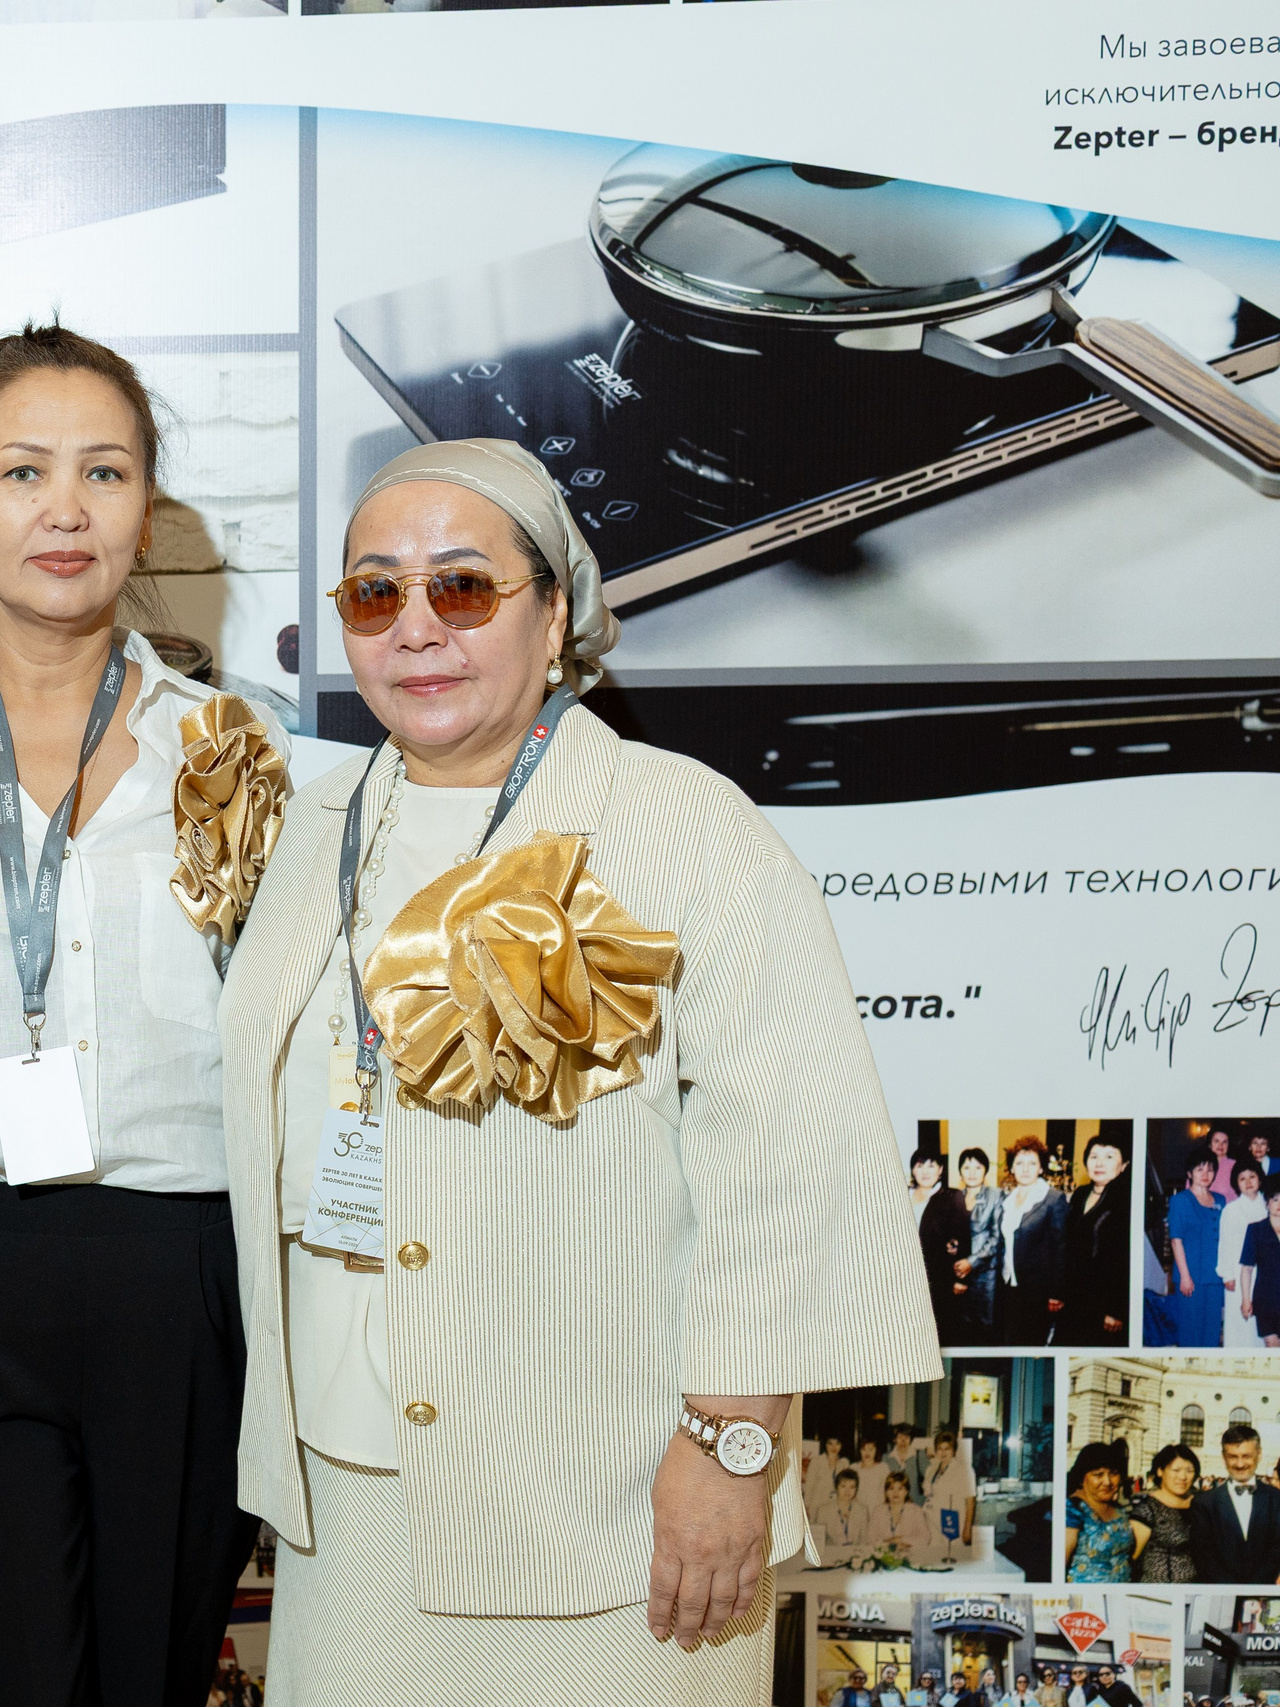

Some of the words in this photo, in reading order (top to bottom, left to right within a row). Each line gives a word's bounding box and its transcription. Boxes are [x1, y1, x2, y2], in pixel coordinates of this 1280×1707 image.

[1100, 33, 1147, 59] Мы
[1158, 36, 1280, 57] завоева
[1045, 81, 1280, 106] исключительно
[1053, 124, 1160, 157] Zepter
[1197, 120, 1280, 153] брен
[505, 735, 543, 799] BIOPTRON
[3, 787, 17, 824] zepter
[39, 866, 53, 905] zepter
[810, 870, 1048, 902] редовыми
[350, 1153, 383, 1165] KAZAKHS
[331, 1199, 379, 1215] УЧАСТНИК
